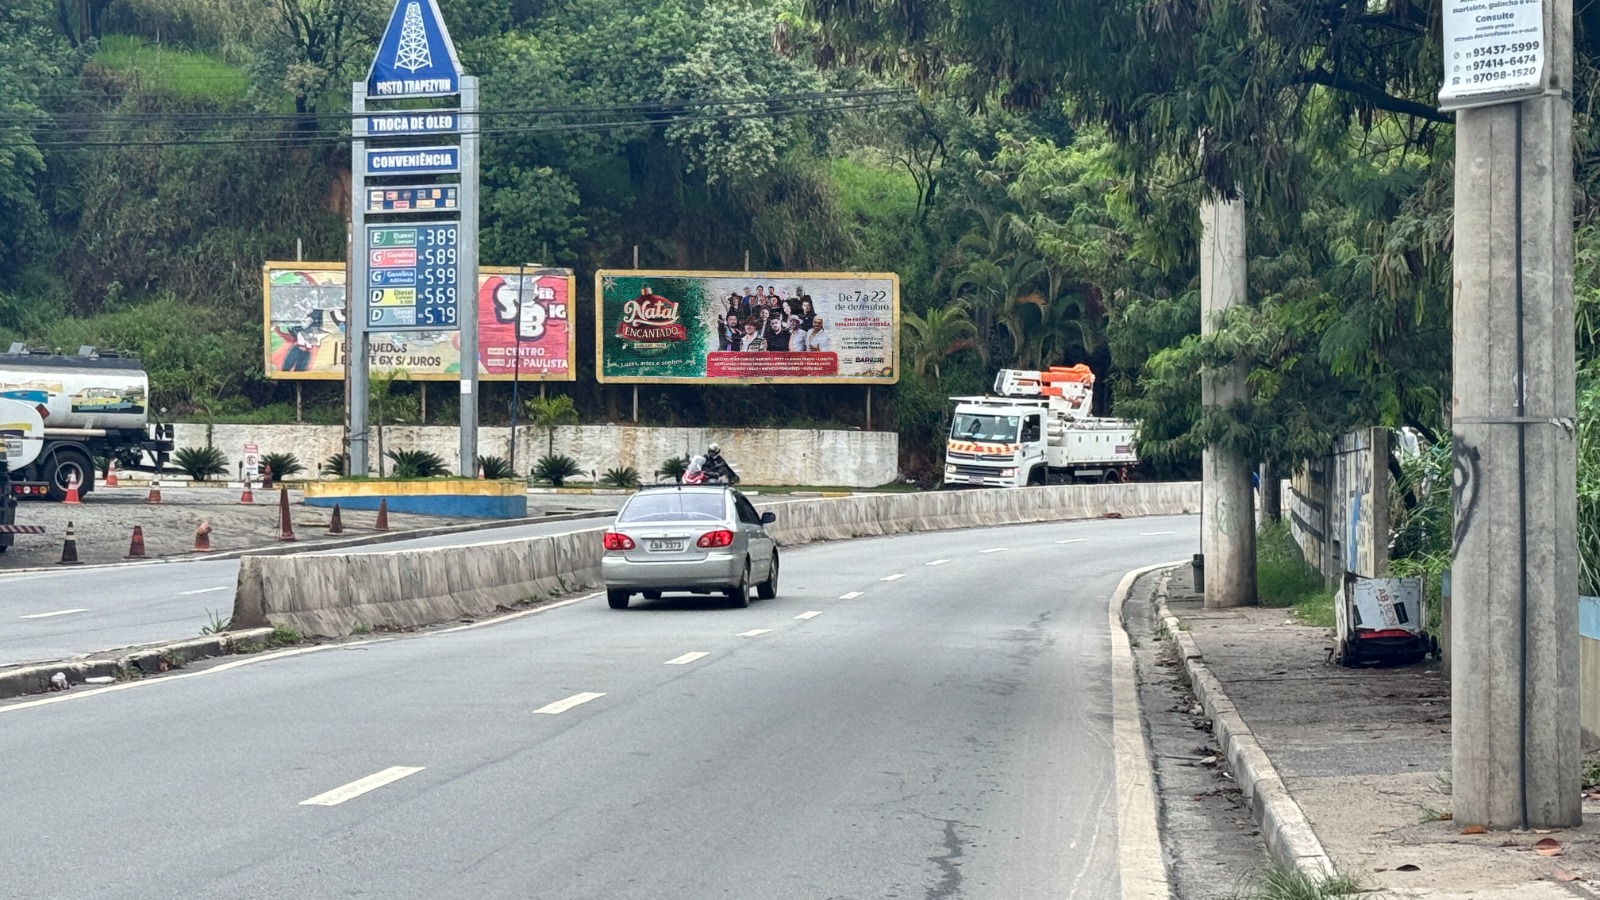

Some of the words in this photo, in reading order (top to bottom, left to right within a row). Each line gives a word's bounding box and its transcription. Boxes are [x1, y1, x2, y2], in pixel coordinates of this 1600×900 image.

[1476, 12, 1514, 22] Consulte
[1474, 40, 1540, 58] 93437-5999
[1474, 54, 1536, 70] 97414-6474
[1474, 66, 1536, 83] 97098-1520
[376, 81, 402, 94] POSTO
[404, 79, 451, 93] TRAPEZYUM
[372, 117, 409, 131] TROCA
[410, 116, 424, 129] DE
[426, 114, 452, 128] ÓLEO
[372, 152, 452, 168] CONVENIÊNCIA
[373, 232, 381, 244] E
[426, 228, 456, 246] 389
[372, 252, 382, 262] G
[387, 250, 414, 258] Gasolina
[425, 248, 456, 266] 589
[372, 271, 382, 282] G
[425, 268, 456, 285] 599
[372, 290, 382, 302] D
[425, 288, 456, 304] 569
[838, 292, 852, 302] De
[854, 291, 862, 302] 7
[870, 290, 886, 302] 22
[372, 309, 382, 320] D
[424, 306, 456, 324] 579
[623, 300, 680, 326] Natal
[624, 326, 679, 338] ENCANTADO
[506, 347, 544, 356] CENTRO
[379, 356, 394, 366] 6X
[396, 356, 406, 366] S/
[406, 356, 442, 366] JUROS
[524, 358, 568, 368] PAULISTA
